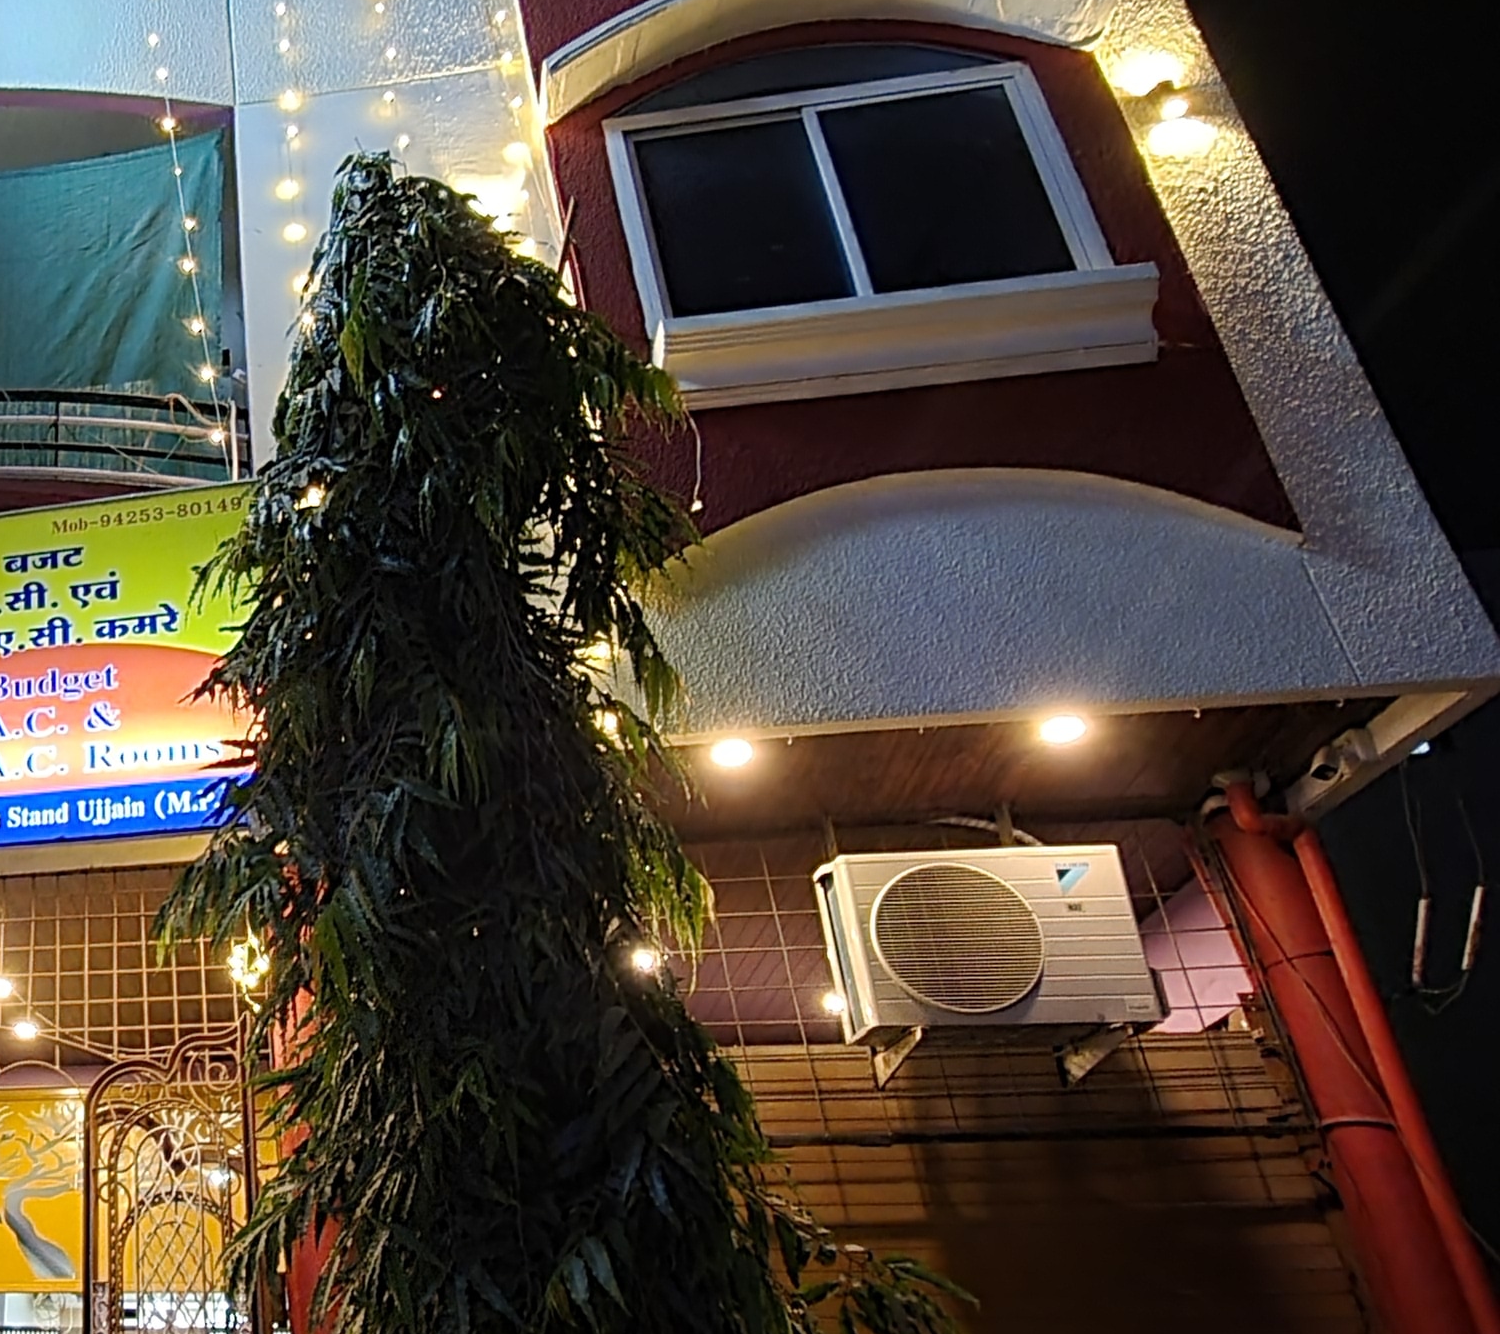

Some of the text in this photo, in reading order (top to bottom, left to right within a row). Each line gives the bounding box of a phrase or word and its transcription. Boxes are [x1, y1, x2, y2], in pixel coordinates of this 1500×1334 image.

[51, 496, 243, 535] Mob-94253-80149
[3, 546, 85, 573] बजट
[70, 571, 120, 607] एवं
[94, 602, 180, 641] कमरे
[84, 700, 122, 733] &
[82, 738, 225, 774] Rooms
[7, 801, 69, 829] Stand
[77, 796, 145, 826] Ujjain
